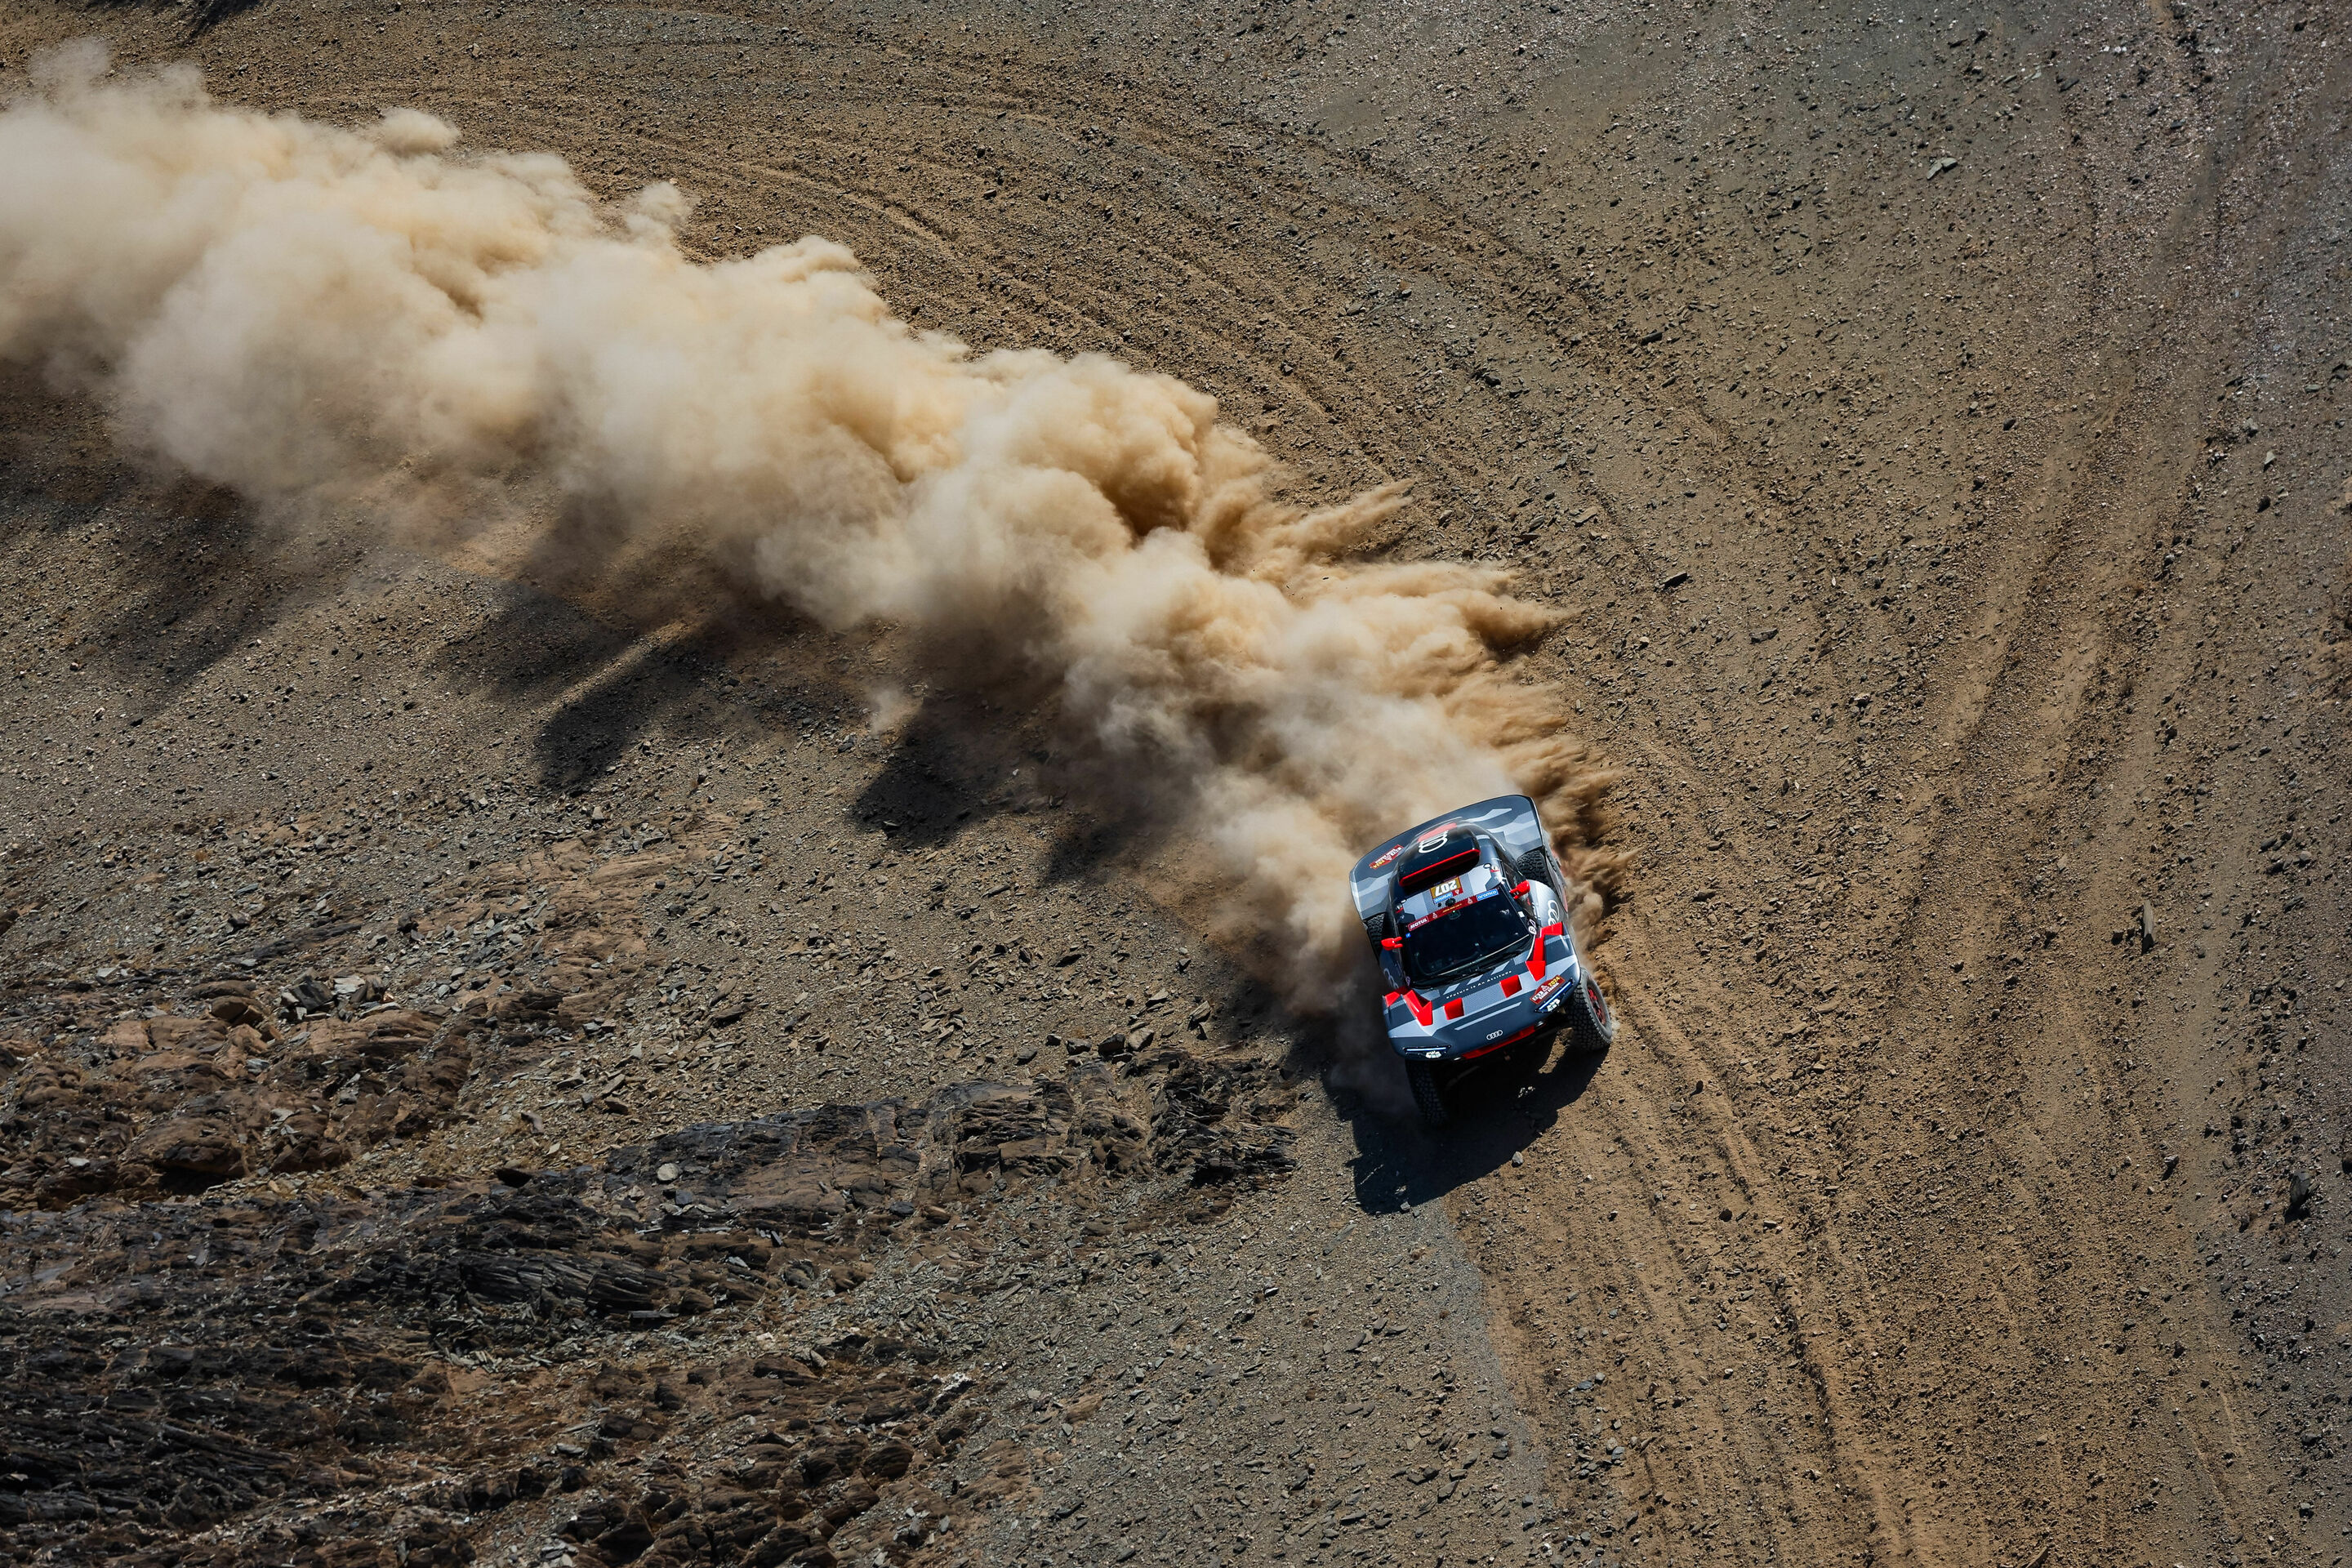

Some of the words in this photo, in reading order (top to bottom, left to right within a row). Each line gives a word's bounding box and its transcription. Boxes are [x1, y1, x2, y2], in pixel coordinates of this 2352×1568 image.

[1435, 880, 1457, 897] 207
[1477, 890, 1497, 899] aramco
[1410, 918, 1428, 929] MOTUL
[1486, 970, 1512, 982] Attitude
[1548, 976, 1561, 987] 2024
